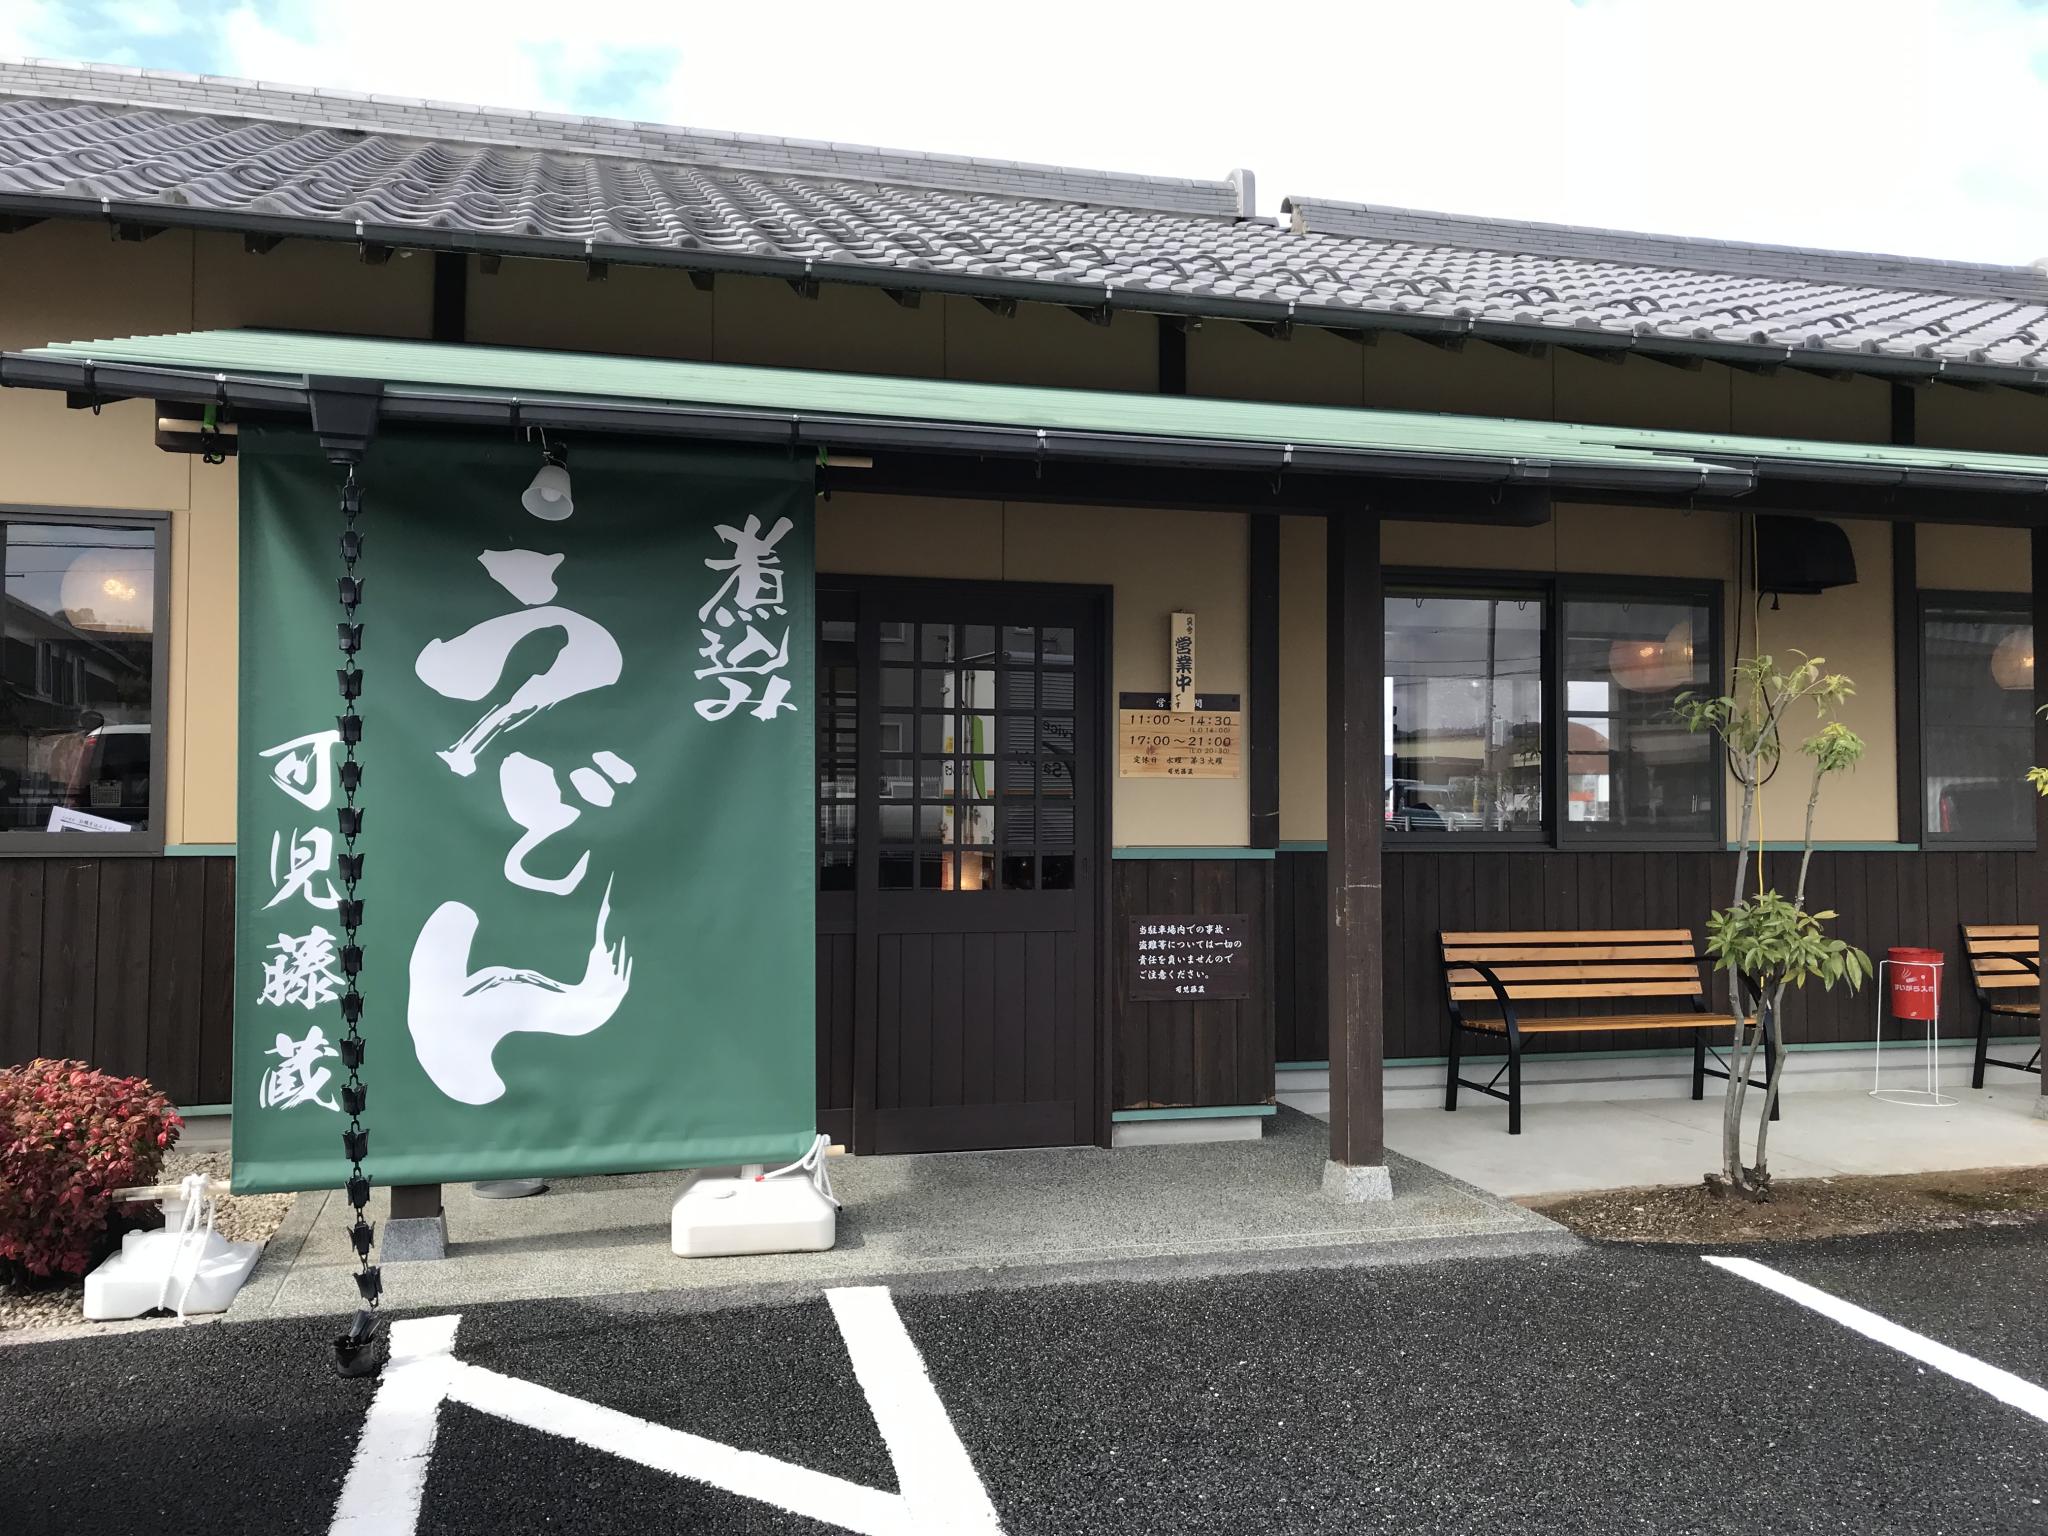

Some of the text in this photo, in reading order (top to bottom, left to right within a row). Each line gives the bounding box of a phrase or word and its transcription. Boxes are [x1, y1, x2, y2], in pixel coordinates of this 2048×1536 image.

[694, 512, 797, 722] 煮込み
[1175, 636, 1193, 693] 営業中
[1155, 697, 1203, 709] 営間
[1133, 755, 1157, 765] 定休日
[407, 548, 638, 1106] うどん
[257, 729, 346, 1113] 可児藤蔵
[1138, 940, 1242, 950] 盗難等については一切の
[1138, 953, 1234, 965] 責任を負いませんので
[1139, 969, 1209, 980] ご注意ください。
